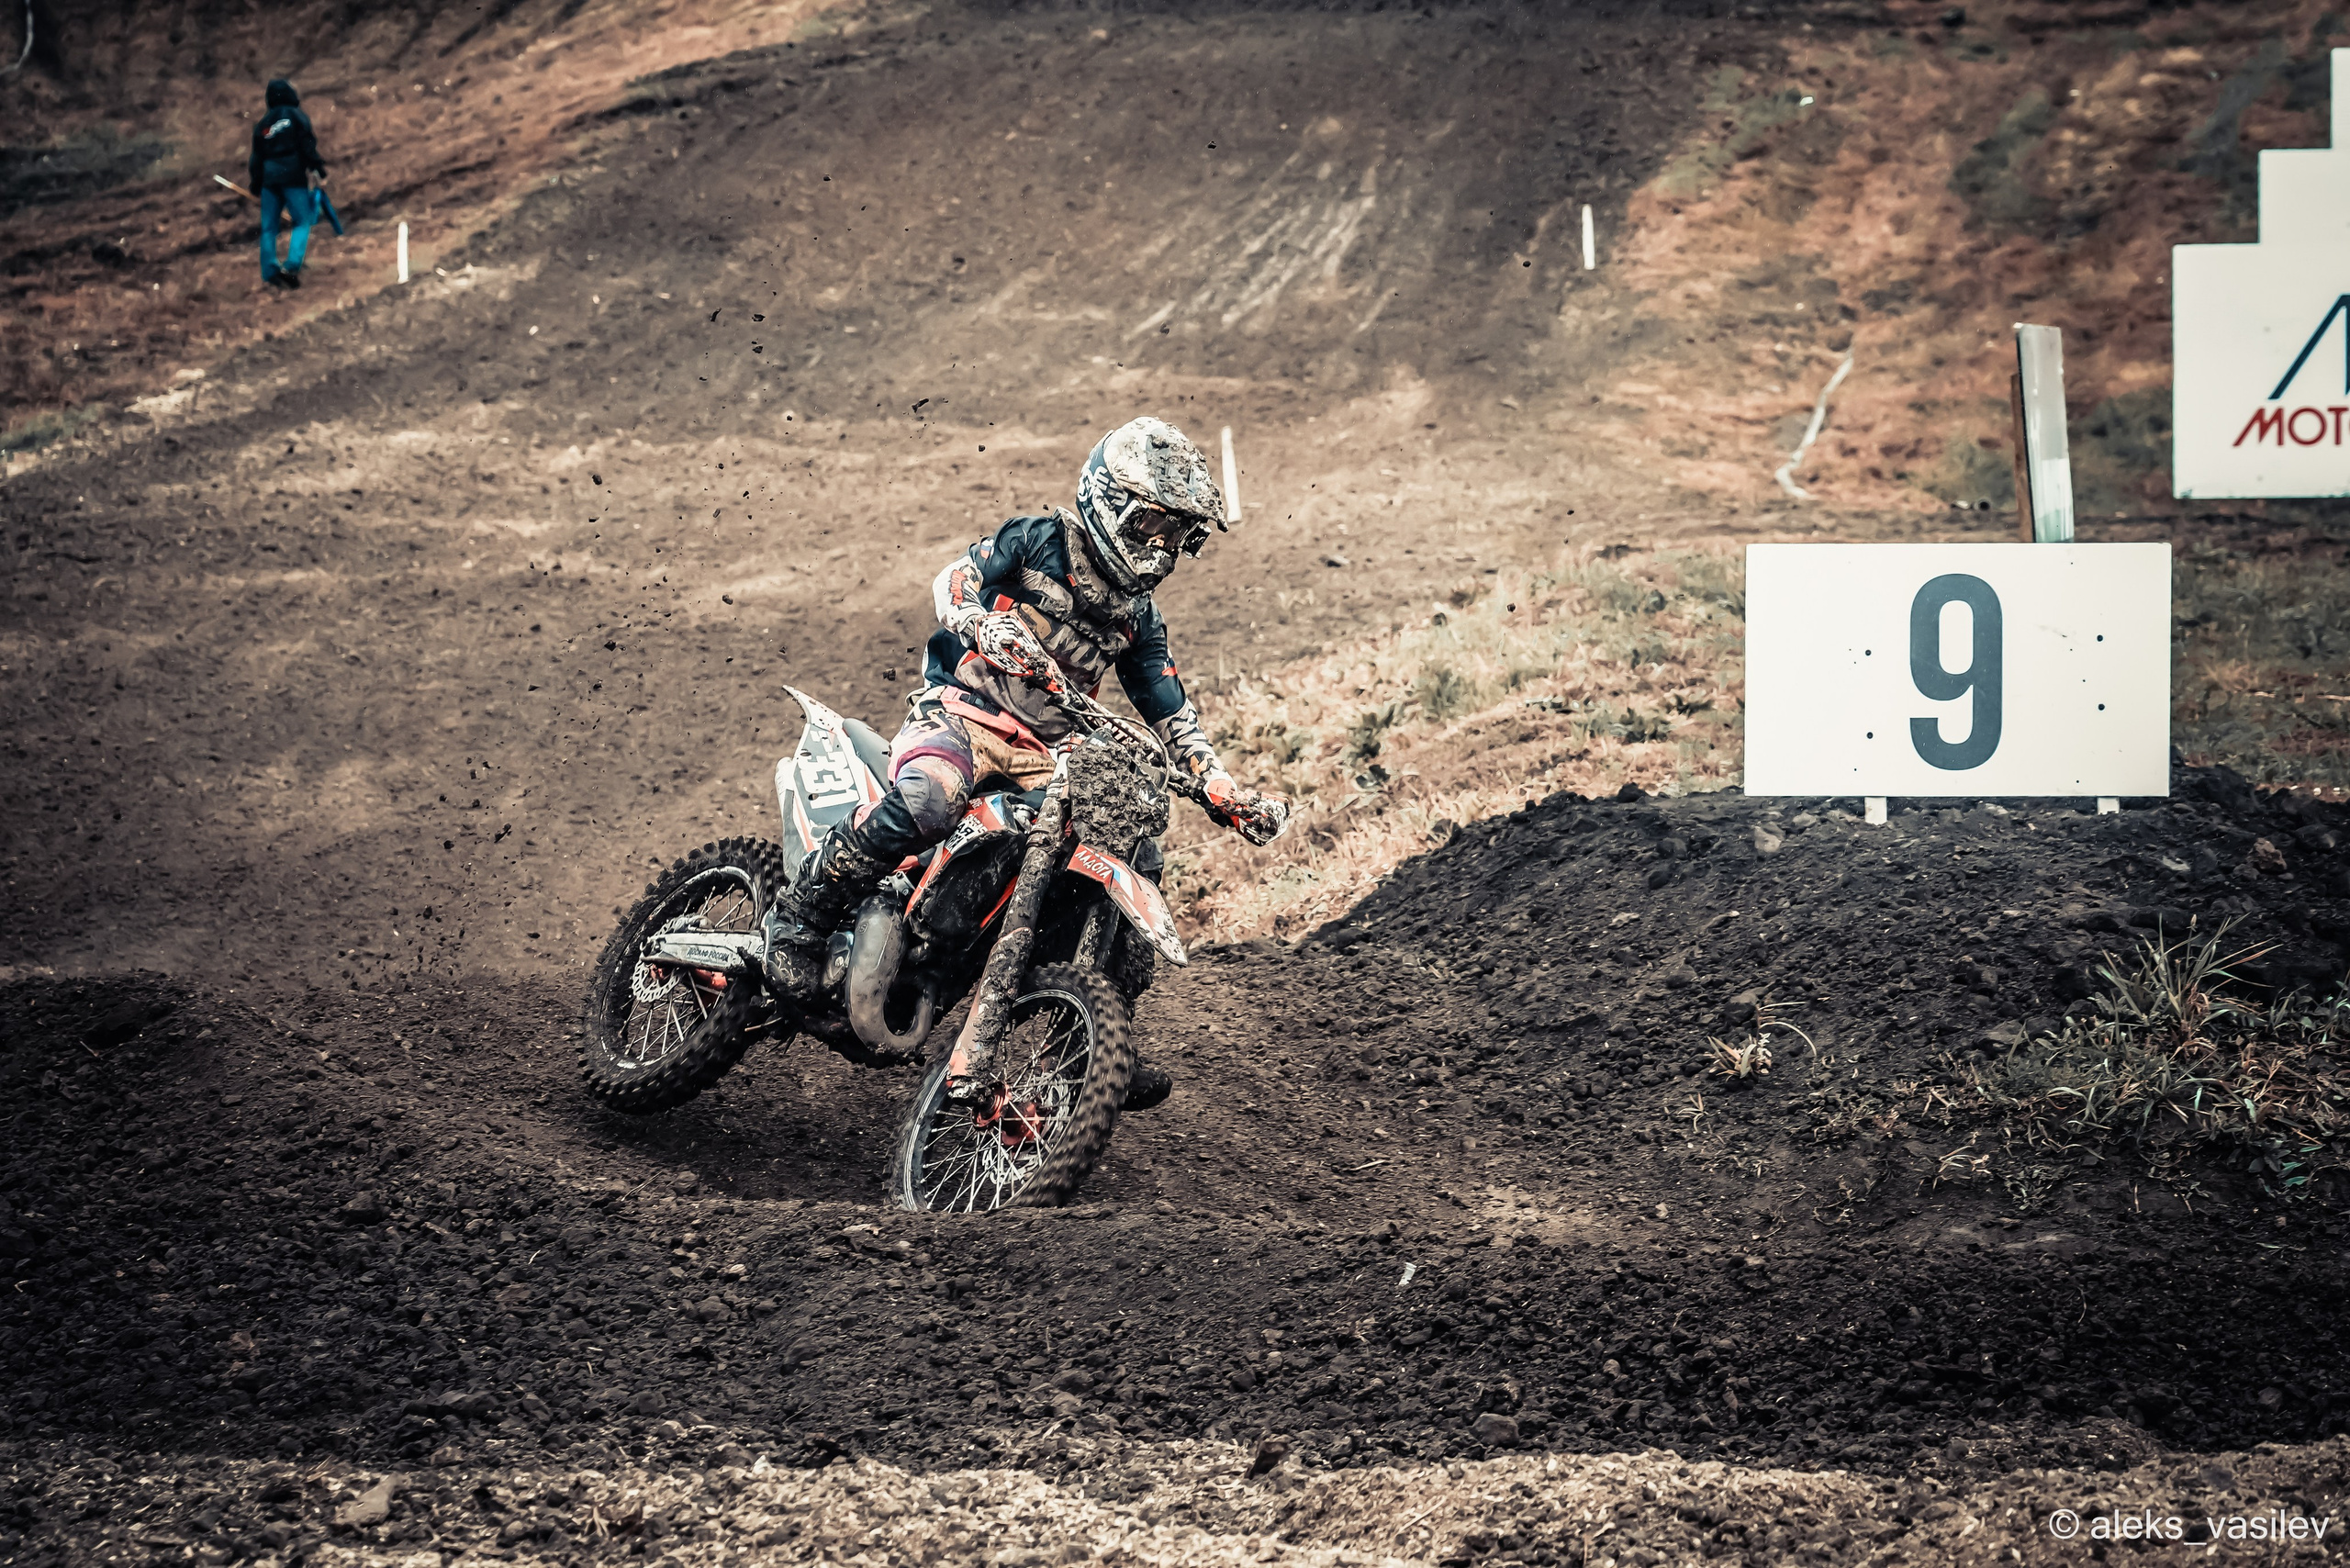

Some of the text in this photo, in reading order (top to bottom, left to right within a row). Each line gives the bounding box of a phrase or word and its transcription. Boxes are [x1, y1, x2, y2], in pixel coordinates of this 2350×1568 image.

[2232, 407, 2350, 447] MOT
[1909, 573, 2002, 770] 9
[797, 751, 860, 810] 331
[1075, 850, 1113, 879] ЛАДОГА
